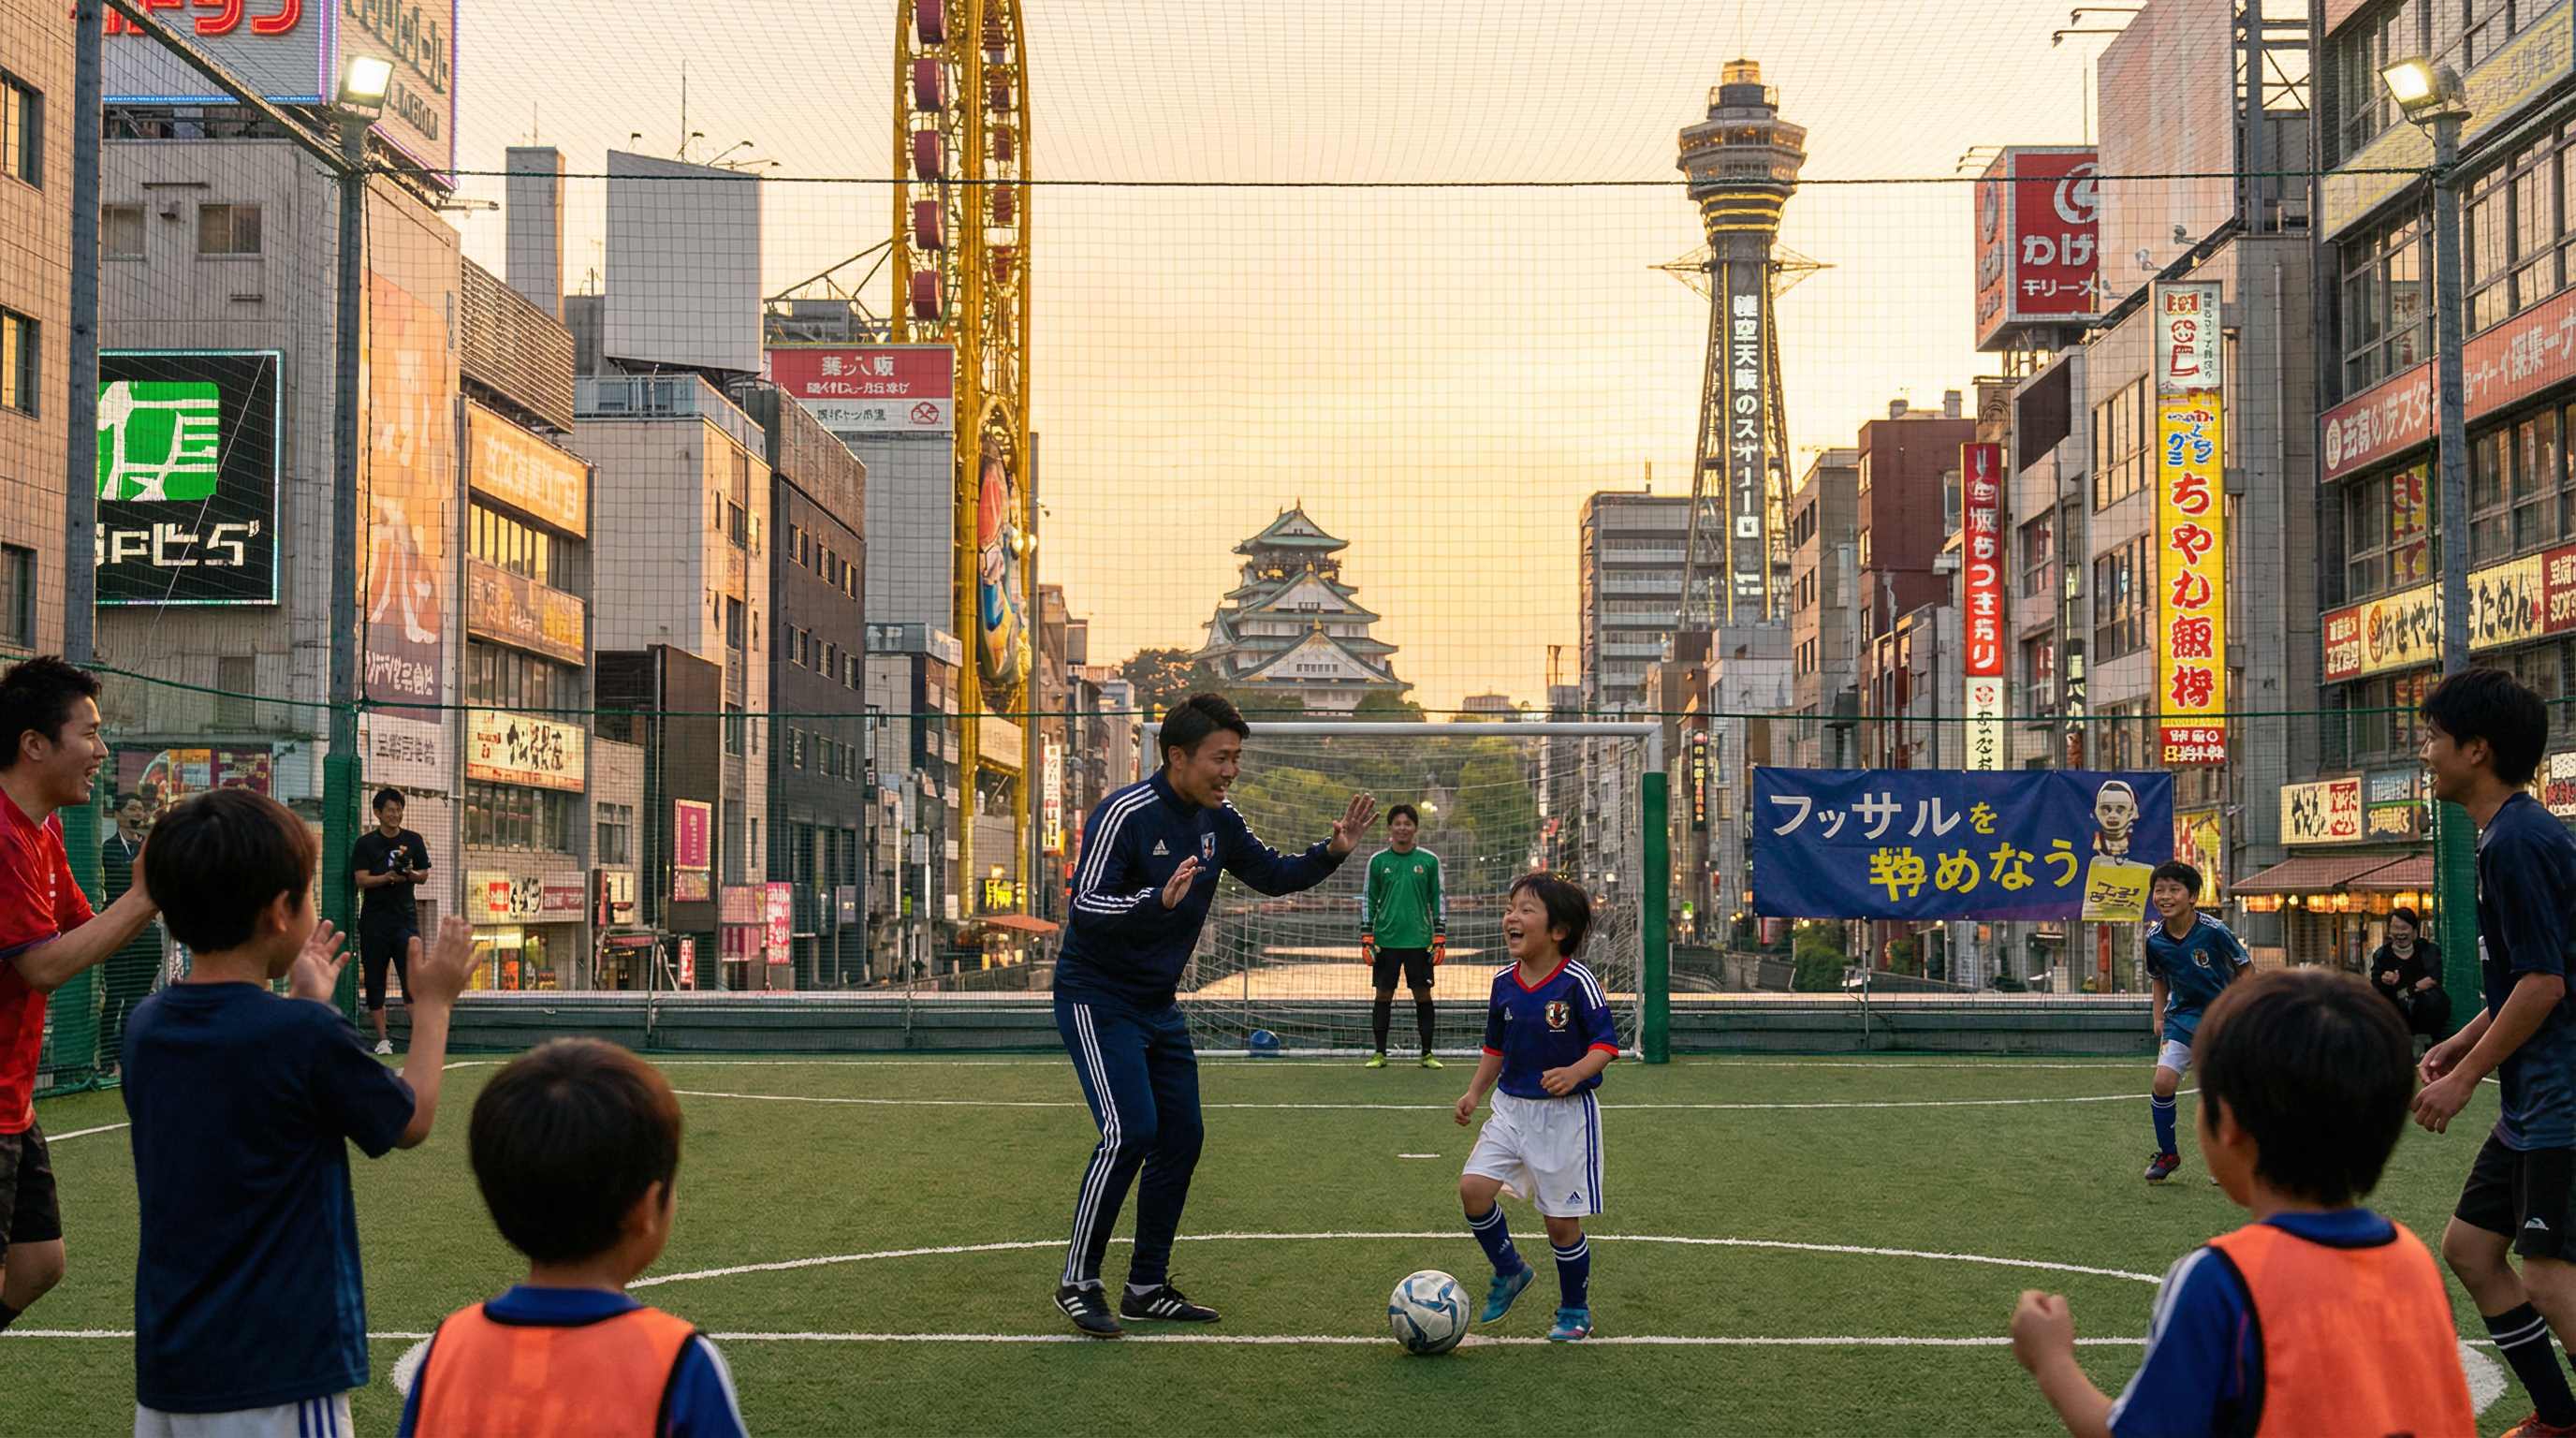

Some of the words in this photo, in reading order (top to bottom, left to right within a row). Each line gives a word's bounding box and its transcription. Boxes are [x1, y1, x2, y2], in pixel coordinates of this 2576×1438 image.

[1770, 791, 1998, 841] フッサルを
